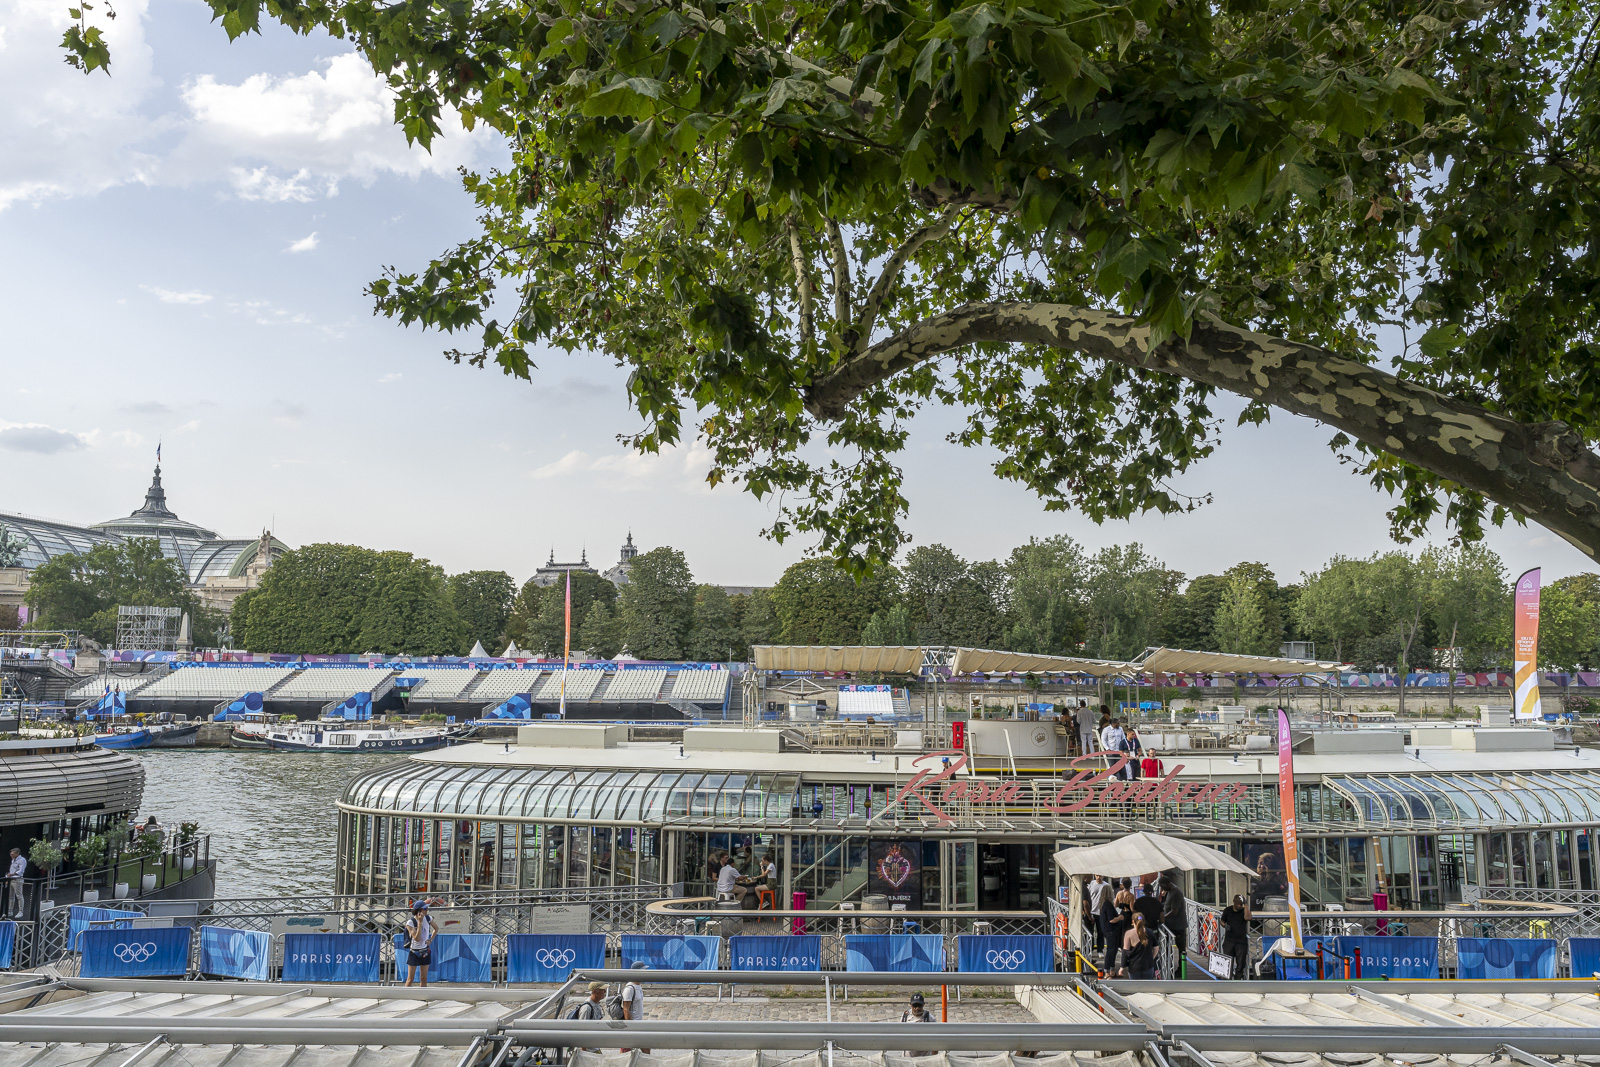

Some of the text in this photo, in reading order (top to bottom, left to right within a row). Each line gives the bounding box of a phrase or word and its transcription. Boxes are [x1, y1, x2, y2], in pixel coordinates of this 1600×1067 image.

[897, 750, 1248, 820] Rosa Bonheur
[1130, 806, 1265, 821] SUR SEINE
[336, 954, 371, 964] 2024
[781, 956, 816, 966] 2024
[1393, 957, 1429, 966] 2024
